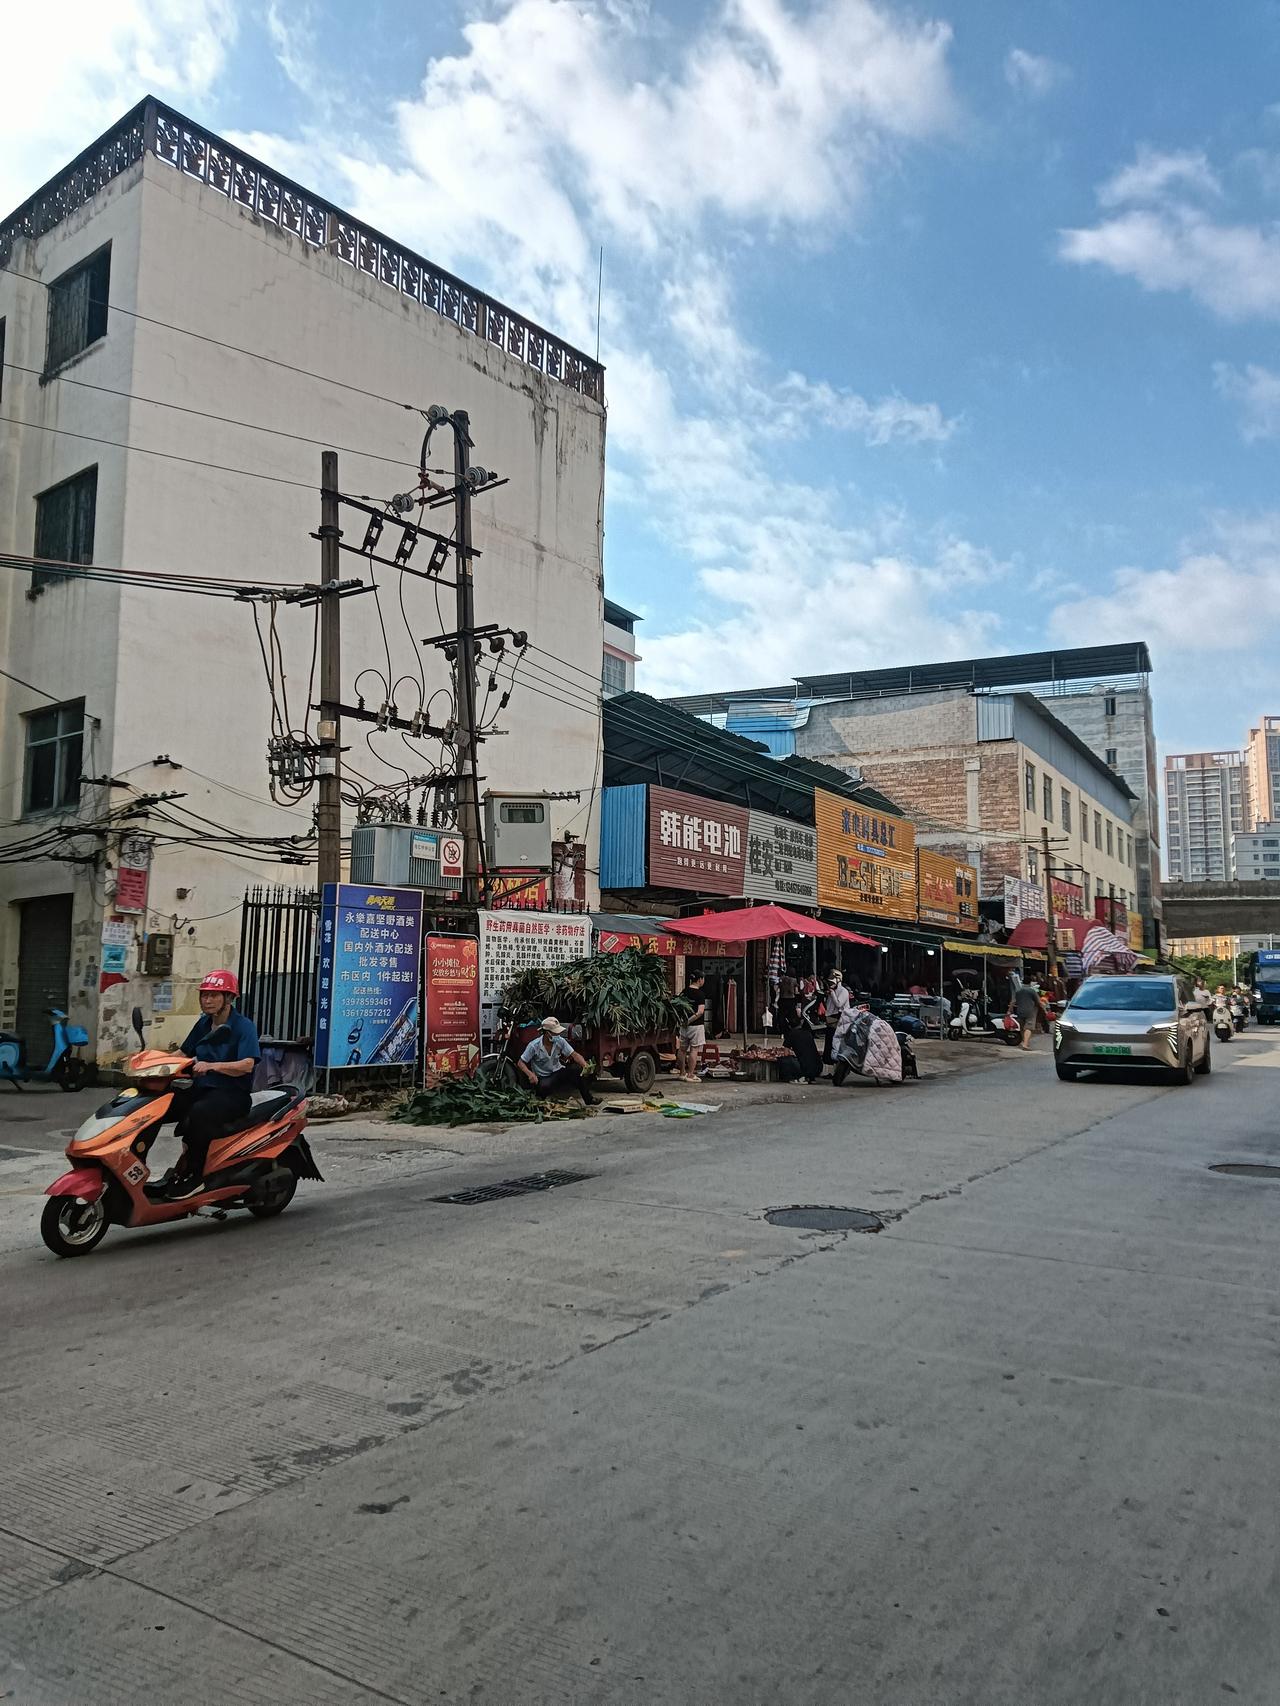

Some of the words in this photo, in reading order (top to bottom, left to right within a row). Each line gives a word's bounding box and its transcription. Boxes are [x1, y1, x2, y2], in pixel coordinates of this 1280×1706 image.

[659, 809, 741, 859] 韩能电池
[359, 927, 400, 939] 配送中心
[344, 941, 413, 955] 国内外酒水配送
[358, 956, 398, 968] 批发零售
[340, 971, 371, 981] 市区内
[341, 997, 392, 1006] 13978593461
[342, 1008, 391, 1017] 13617857212
[127, 1165, 144, 1181] 58
